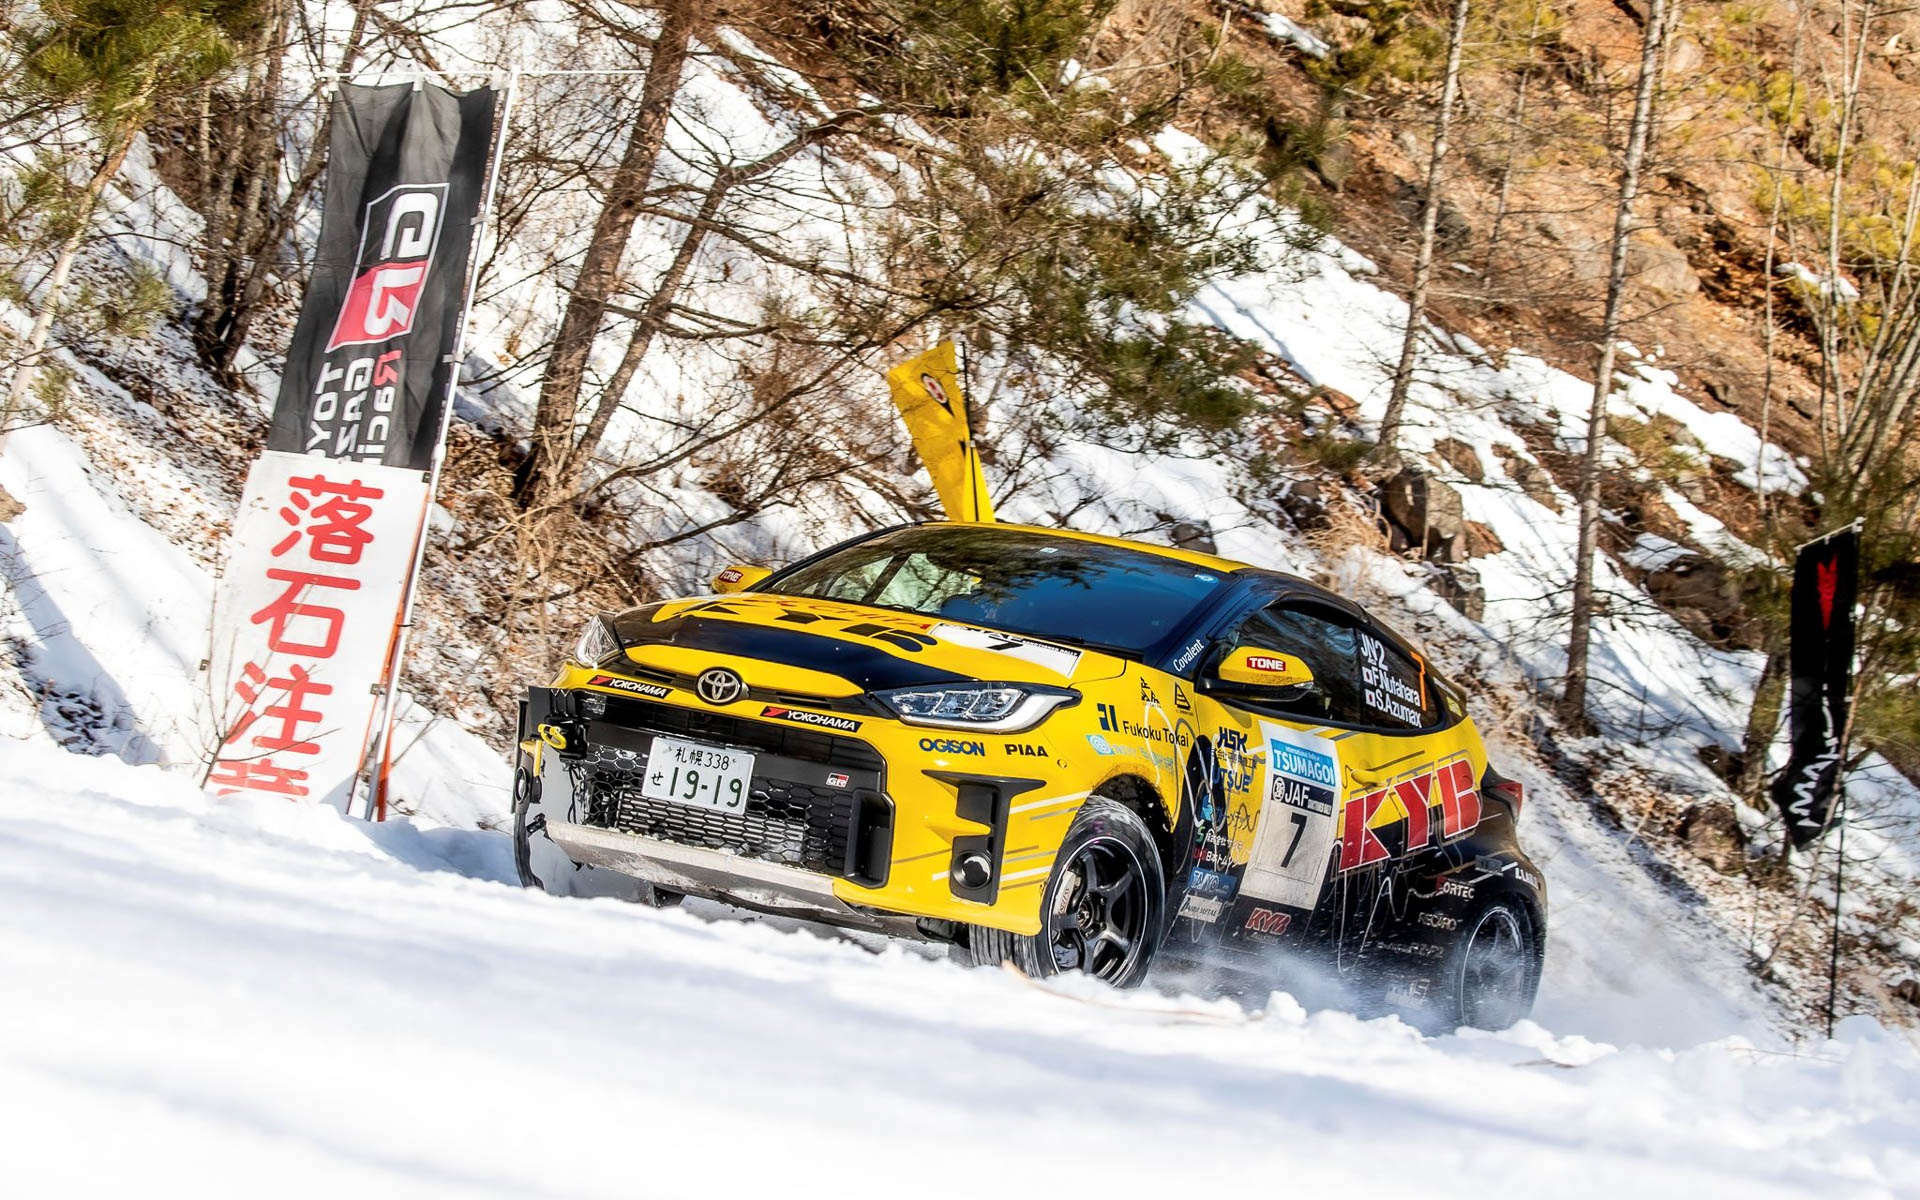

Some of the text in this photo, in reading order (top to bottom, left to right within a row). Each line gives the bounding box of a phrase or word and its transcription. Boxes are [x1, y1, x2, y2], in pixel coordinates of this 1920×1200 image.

[1173, 638, 1204, 671] Covalent
[1249, 657, 1284, 671] TONE
[1361, 634, 1389, 671] JN2
[609, 678, 667, 697] YOKOHAMA
[787, 710, 855, 730] YOKOHAMA
[1122, 720, 1189, 747] Fukoku Tokai
[918, 738, 1048, 757] OGISON PIAA
[1273, 748, 1335, 785] TSUMAGOI
[651, 767, 742, 807] せ 19-19
[1284, 781, 1310, 807] JAF
[1339, 758, 1482, 873] KYB
[1280, 812, 1308, 868] 7
[1245, 907, 1292, 935] KYB
[1417, 911, 1458, 931] RECARO
